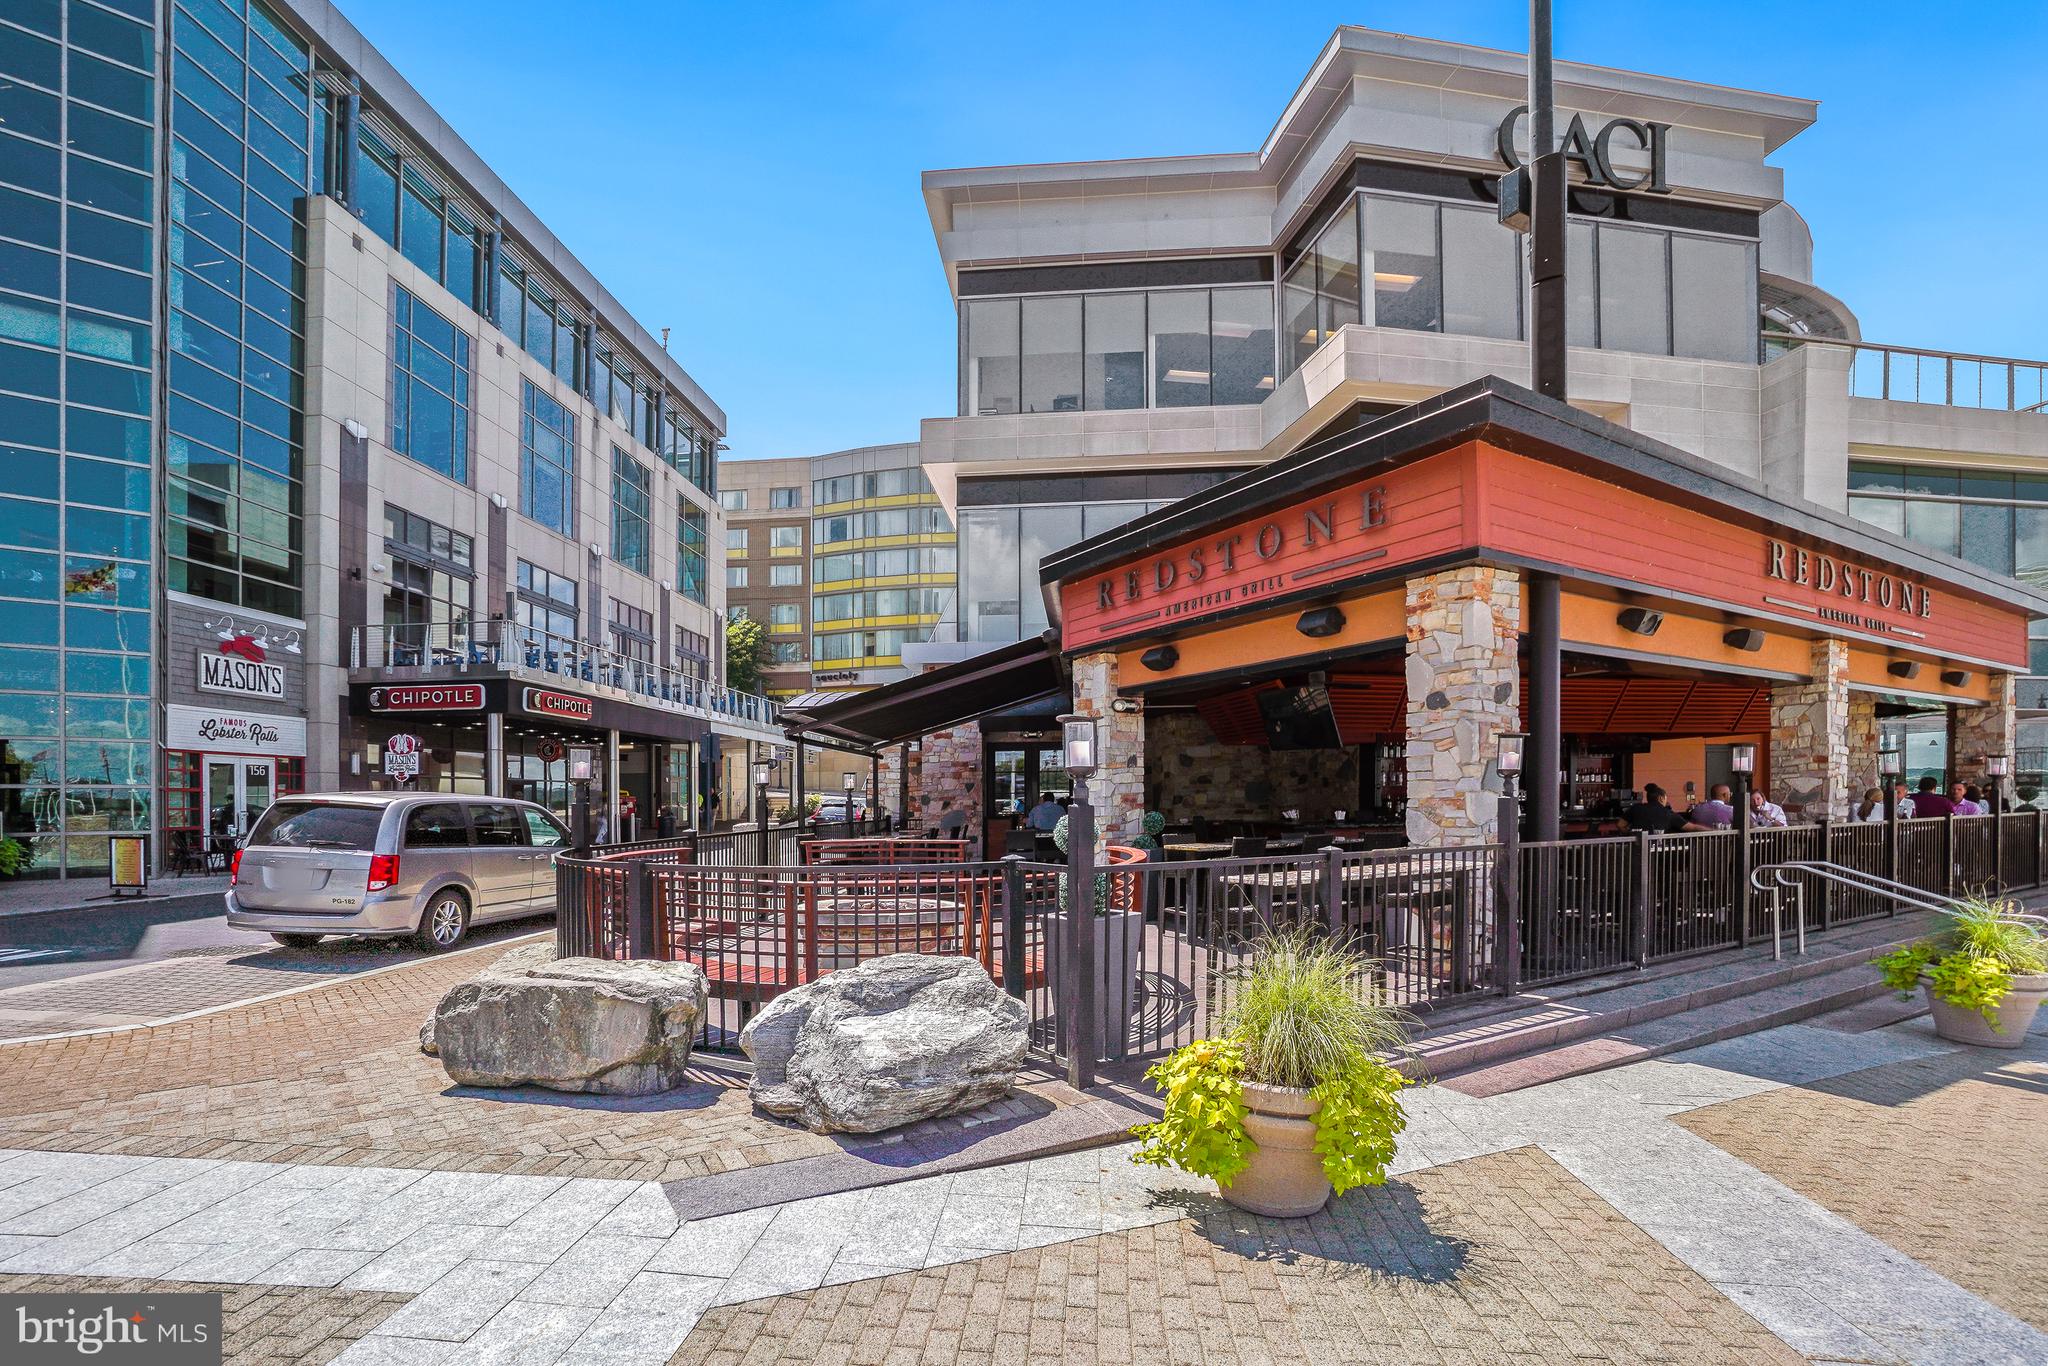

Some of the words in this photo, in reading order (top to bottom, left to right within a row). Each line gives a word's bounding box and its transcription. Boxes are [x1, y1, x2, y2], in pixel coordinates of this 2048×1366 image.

[1498, 105, 1673, 194] CACI
[1096, 486, 1386, 611] REDSTONE
[1768, 540, 1931, 618] REDSTONE
[1165, 589, 1232, 617] AMERICAN
[1242, 576, 1284, 597] GRILL
[1819, 607, 1861, 626] AMERICAN
[1866, 617, 1889, 632] GRILL
[203, 656, 282, 694] MASON'S
[390, 690, 474, 704] CHIPOTLE
[546, 697, 592, 715] CHIPOTLE
[199, 719, 247, 741] Lobster
[250, 723, 279, 745] Rolls
[219, 718, 247, 727] FAMOUS
[249, 765, 266, 776] 156
